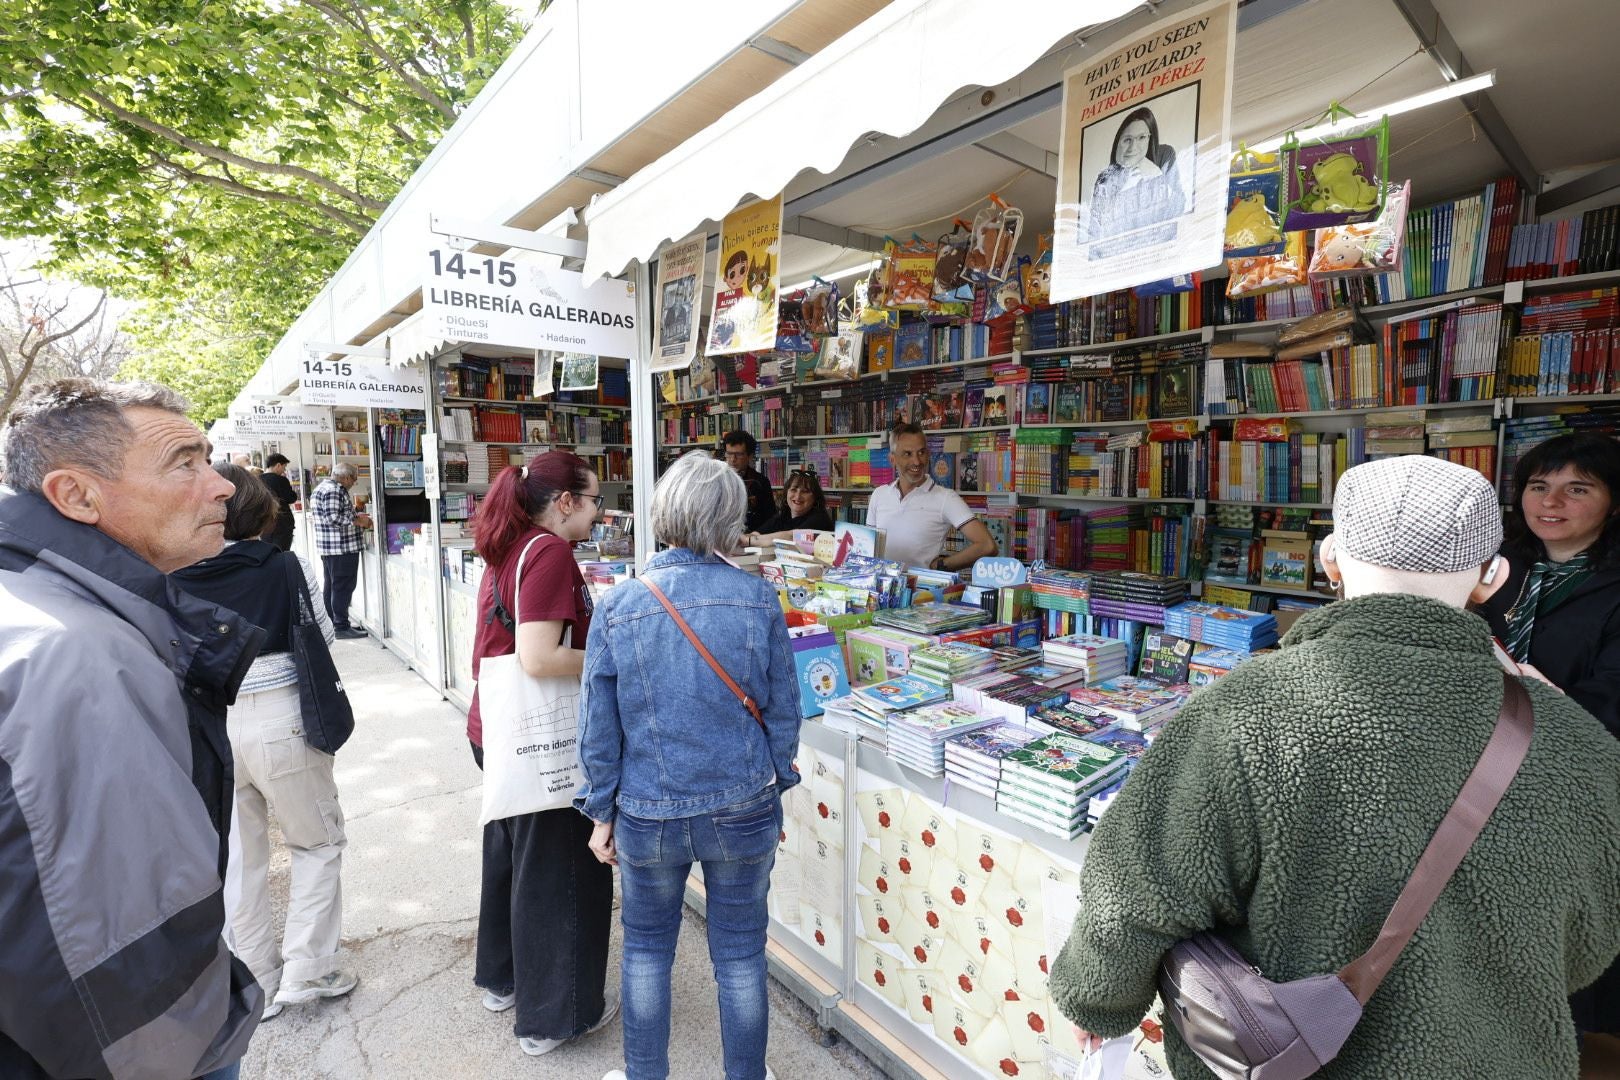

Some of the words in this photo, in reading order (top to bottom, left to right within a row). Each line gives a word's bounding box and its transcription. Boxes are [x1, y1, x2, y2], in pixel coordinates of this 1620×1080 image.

[1085, 55, 1122, 86] HAVE
[1126, 37, 1160, 64] YOU
[1162, 17, 1209, 48] SEEN
[1089, 76, 1121, 102] THIS
[1127, 42, 1202, 84] WIZARD?
[1080, 83, 1145, 122] PATRICIA
[1151, 57, 1206, 91] PÉREZ
[428, 249, 517, 287] 14-15
[430, 287, 524, 315] LIBRERÍA
[528, 304, 635, 329] GALERADAS
[446, 327, 489, 340] Tinturas
[546, 332, 586, 345] Hadarion
[303, 360, 352, 376] 14-15
[304, 379, 356, 390] LIBRERÍA
[359, 382, 424, 394] GALERADAS
[253, 405, 283, 414] 16-17
[516, 743, 550, 755] centre
